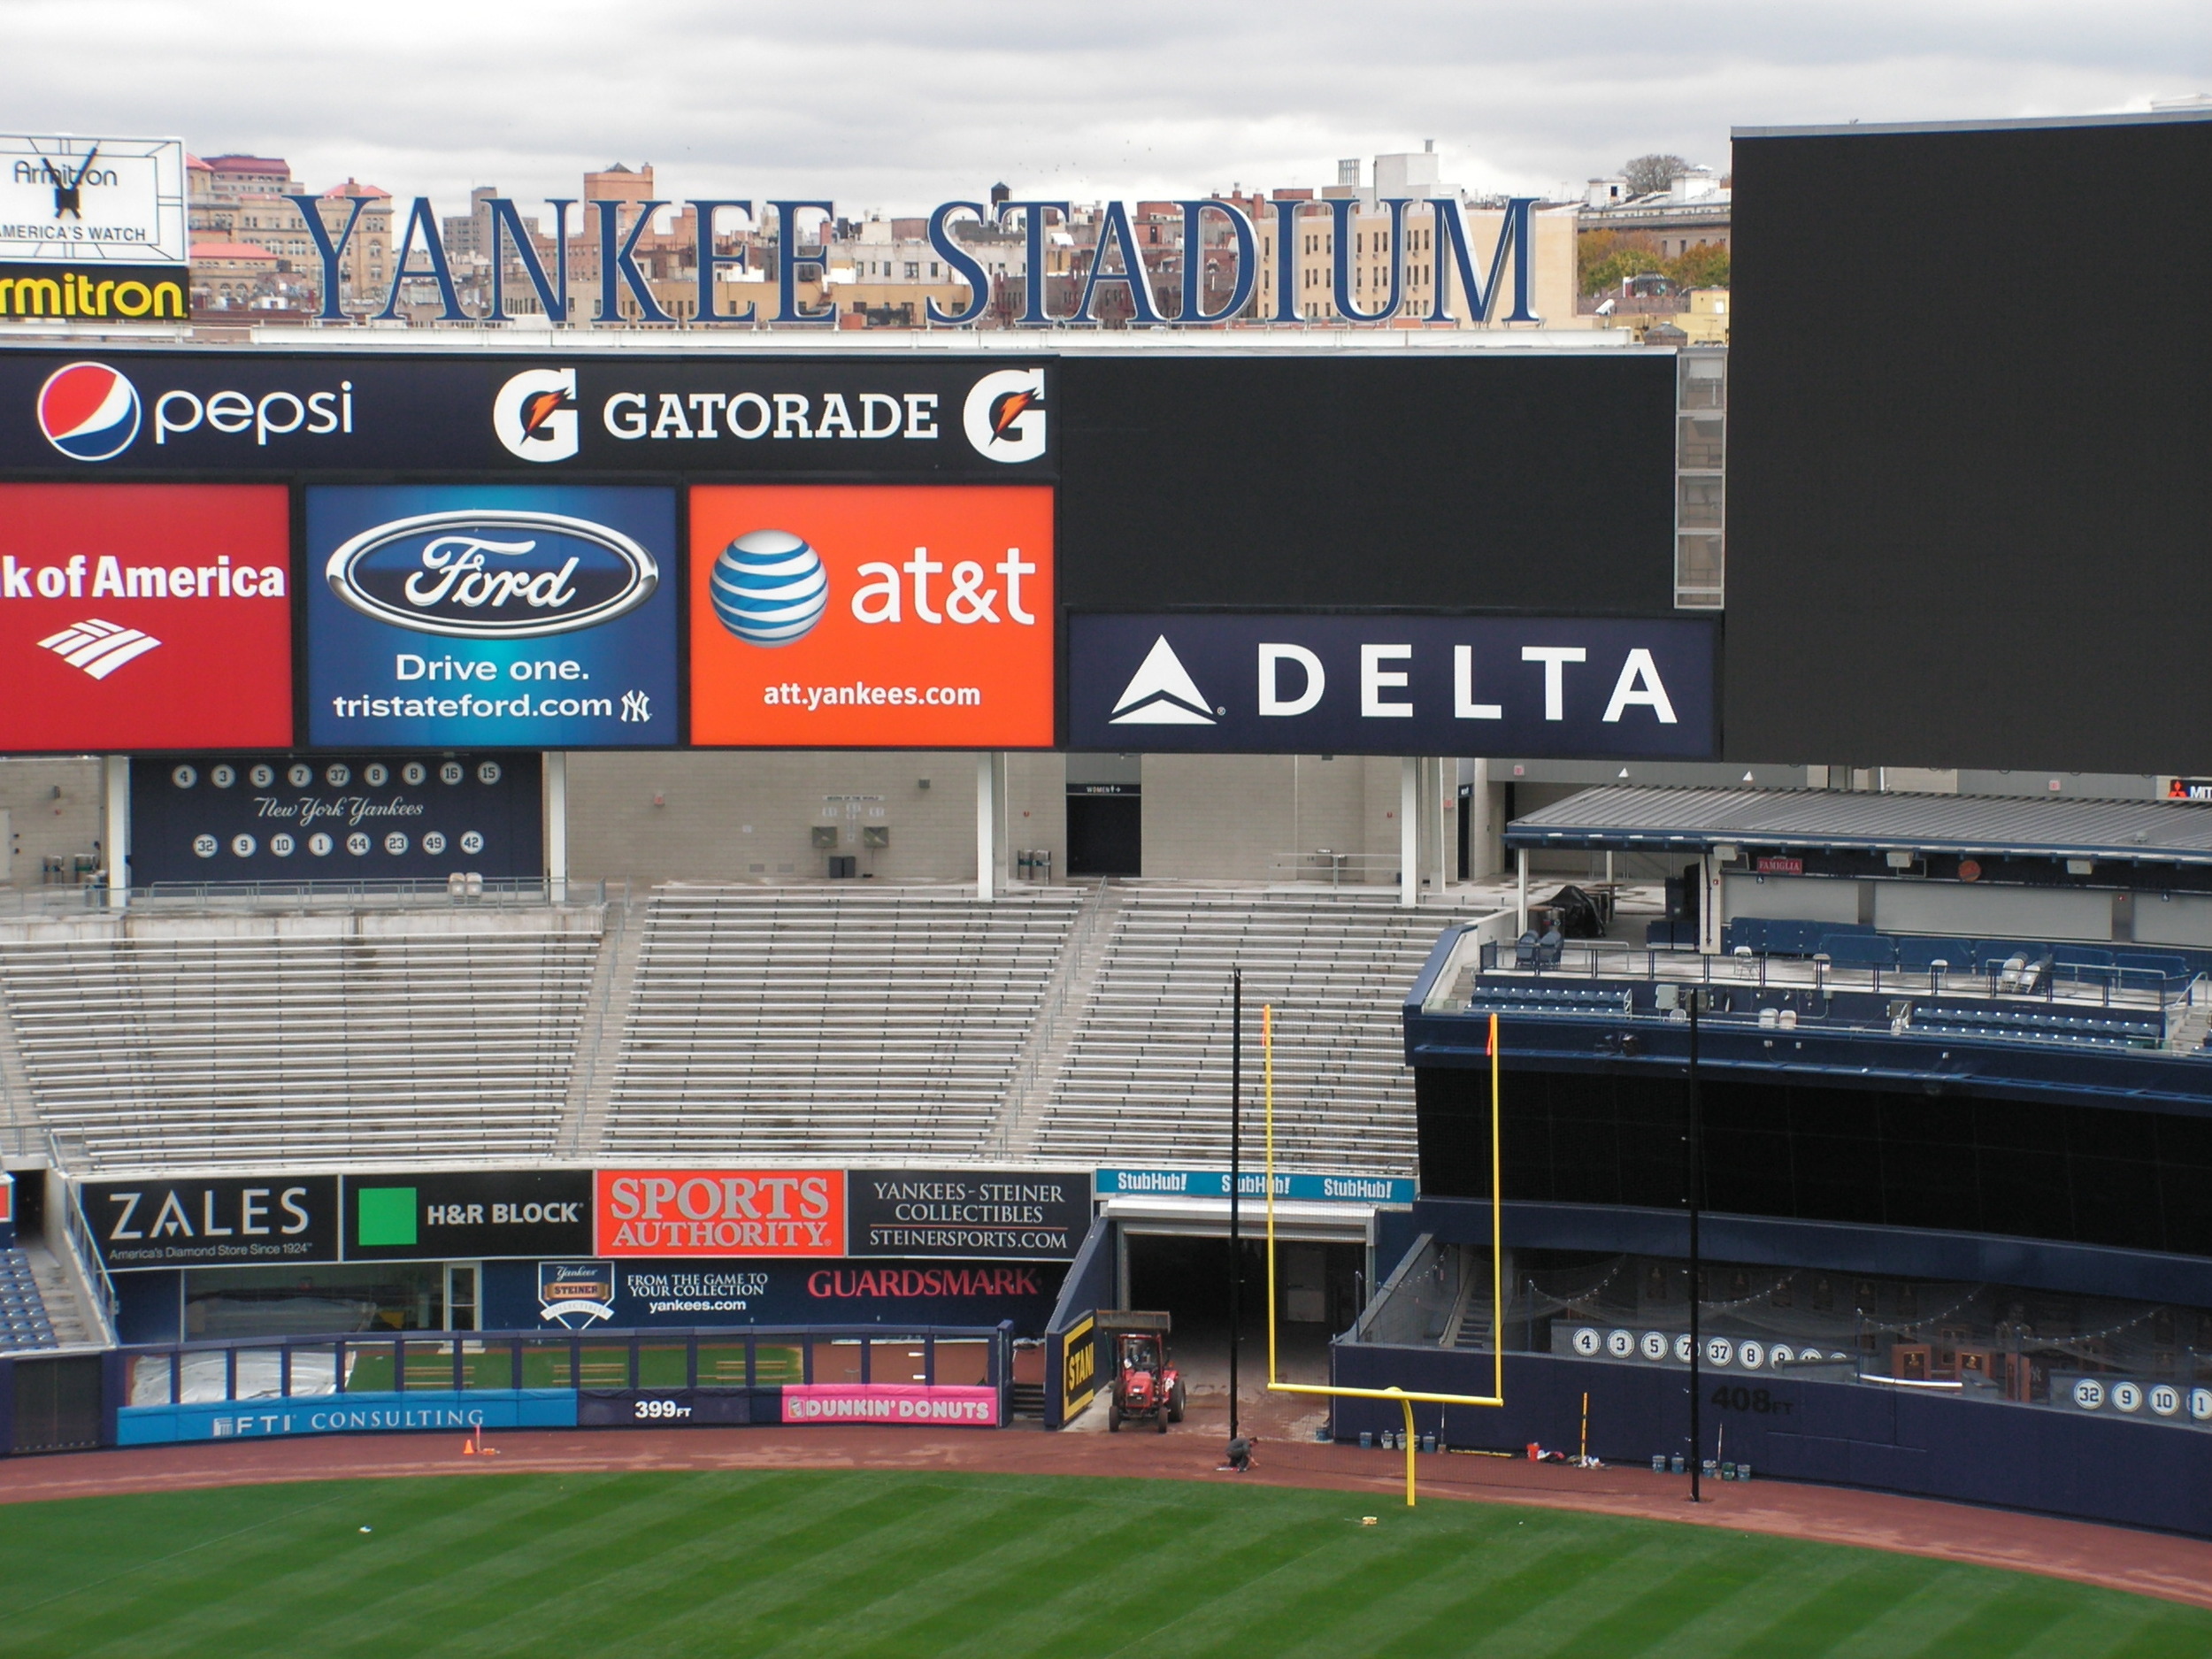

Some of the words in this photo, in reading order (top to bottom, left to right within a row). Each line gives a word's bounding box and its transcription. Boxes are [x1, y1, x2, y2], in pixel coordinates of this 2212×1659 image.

[15, 160, 118, 187] Armiton
[0, 224, 83, 240] MERICA'S
[88, 227, 146, 241] WATCH
[281, 195, 839, 324] YANKEE
[926, 197, 1541, 325] STADIUM
[155, 380, 353, 445] pepsi
[603, 393, 938, 440] GATORADE
[36, 555, 87, 598] of
[91, 555, 285, 598] America
[404, 536, 580, 607] Ford
[851, 547, 1036, 625] at&t
[396, 654, 497, 680] Drive
[510, 659, 589, 680] one.
[764, 681, 981, 711] att.yankees.com
[1258, 643, 1678, 724] DELTA
[333, 694, 612, 718] tristateford.com
[180, 771, 188, 782] 4
[219, 771, 227, 782] 3
[257, 770, 266, 781] 5
[296, 770, 304, 781] 7
[330, 769, 346, 781] 37
[372, 768, 380, 780] 8
[410, 768, 419, 780] 8
[445, 767, 458, 779] 16
[482, 766, 495, 779] 15
[253, 797, 298, 818] New
[299, 796, 348, 827] York
[348, 795, 424, 826] Yankees
[197, 840, 213, 852] 32
[240, 840, 249, 851] 9
[276, 839, 289, 851] 10
[318, 839, 324, 850] 1
[349, 837, 366, 849] 44
[388, 837, 404, 849] 23
[426, 837, 442, 849] 49
[464, 837, 479, 849] 42
[1759, 860, 1800, 872] FAMIGLIA
[1118, 1172, 1187, 1191] StubHub!
[1221, 1175, 1290, 1194] SubHb!
[1324, 1178, 1392, 1199] StubHub!
[611, 1178, 829, 1220] SPORTS
[109, 1187, 309, 1240] ZALES
[427, 1203, 484, 1225] H&R
[492, 1202, 579, 1224] BLOCK
[895, 1203, 1043, 1223] COLLECTIBLES
[611, 1221, 828, 1247] AUTHORITY
[870, 1229, 1067, 1249] STEINERSPORTS.COM
[109, 1248, 163, 1260] America's
[165, 1245, 216, 1257] Diamond
[218, 1244, 247, 1256] Store
[250, 1243, 280, 1255] Since
[556, 1265, 598, 1282] Yankees
[627, 1274, 670, 1286] FROM
[671, 1274, 700, 1286] THE
[703, 1273, 744, 1286] GAME
[747, 1272, 768, 1285] TO
[808, 1269, 1039, 1297] GUARDSMARK
[555, 1285, 598, 1294] STEINER
[629, 1285, 671, 1297] YOUR
[672, 1284, 764, 1297] COLLECTION
[649, 1299, 747, 1314] yankees.com
[1581, 1335, 1591, 1348] 4
[1616, 1337, 1625, 1351] 3
[1650, 1339, 1659, 1353] 5
[1683, 1341, 1691, 1356] 7
[1711, 1345, 1728, 1359] 37
[1747, 1348, 1755, 1363] 8
[806, 1399, 896, 1417] DUNKIN'
[899, 1400, 990, 1419] DONUTS
[2079, 1386, 2099, 1402] 32
[2122, 1390, 2131, 1405] 9
[2156, 1393, 2172, 1409] 10
[2199, 1397, 2204, 1412] 1
[236, 1414, 291, 1434] FTI
[311, 1409, 484, 1430] CONSULTING
